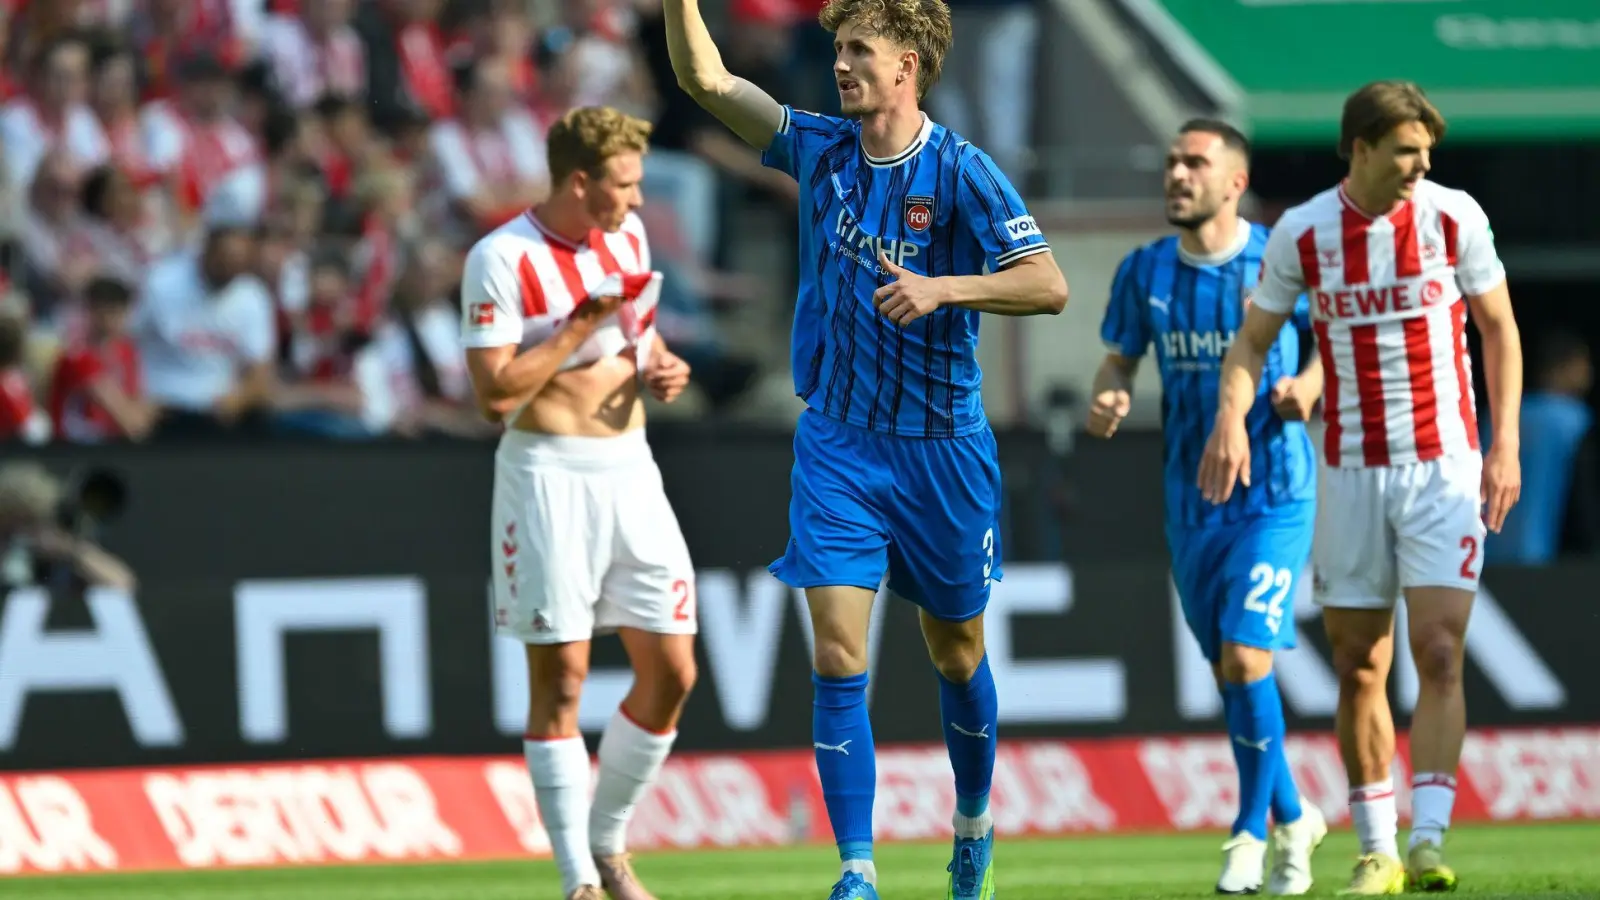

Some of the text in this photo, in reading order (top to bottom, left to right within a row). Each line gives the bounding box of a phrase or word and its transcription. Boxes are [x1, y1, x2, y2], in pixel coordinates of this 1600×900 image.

[910, 212, 928, 224] FCH
[838, 245, 873, 269] PORSCHE
[1316, 284, 1413, 318] REWE
[982, 527, 994, 578] 3
[1459, 535, 1478, 580] 2
[671, 579, 690, 621] 2
[1243, 561, 1293, 617] 22
